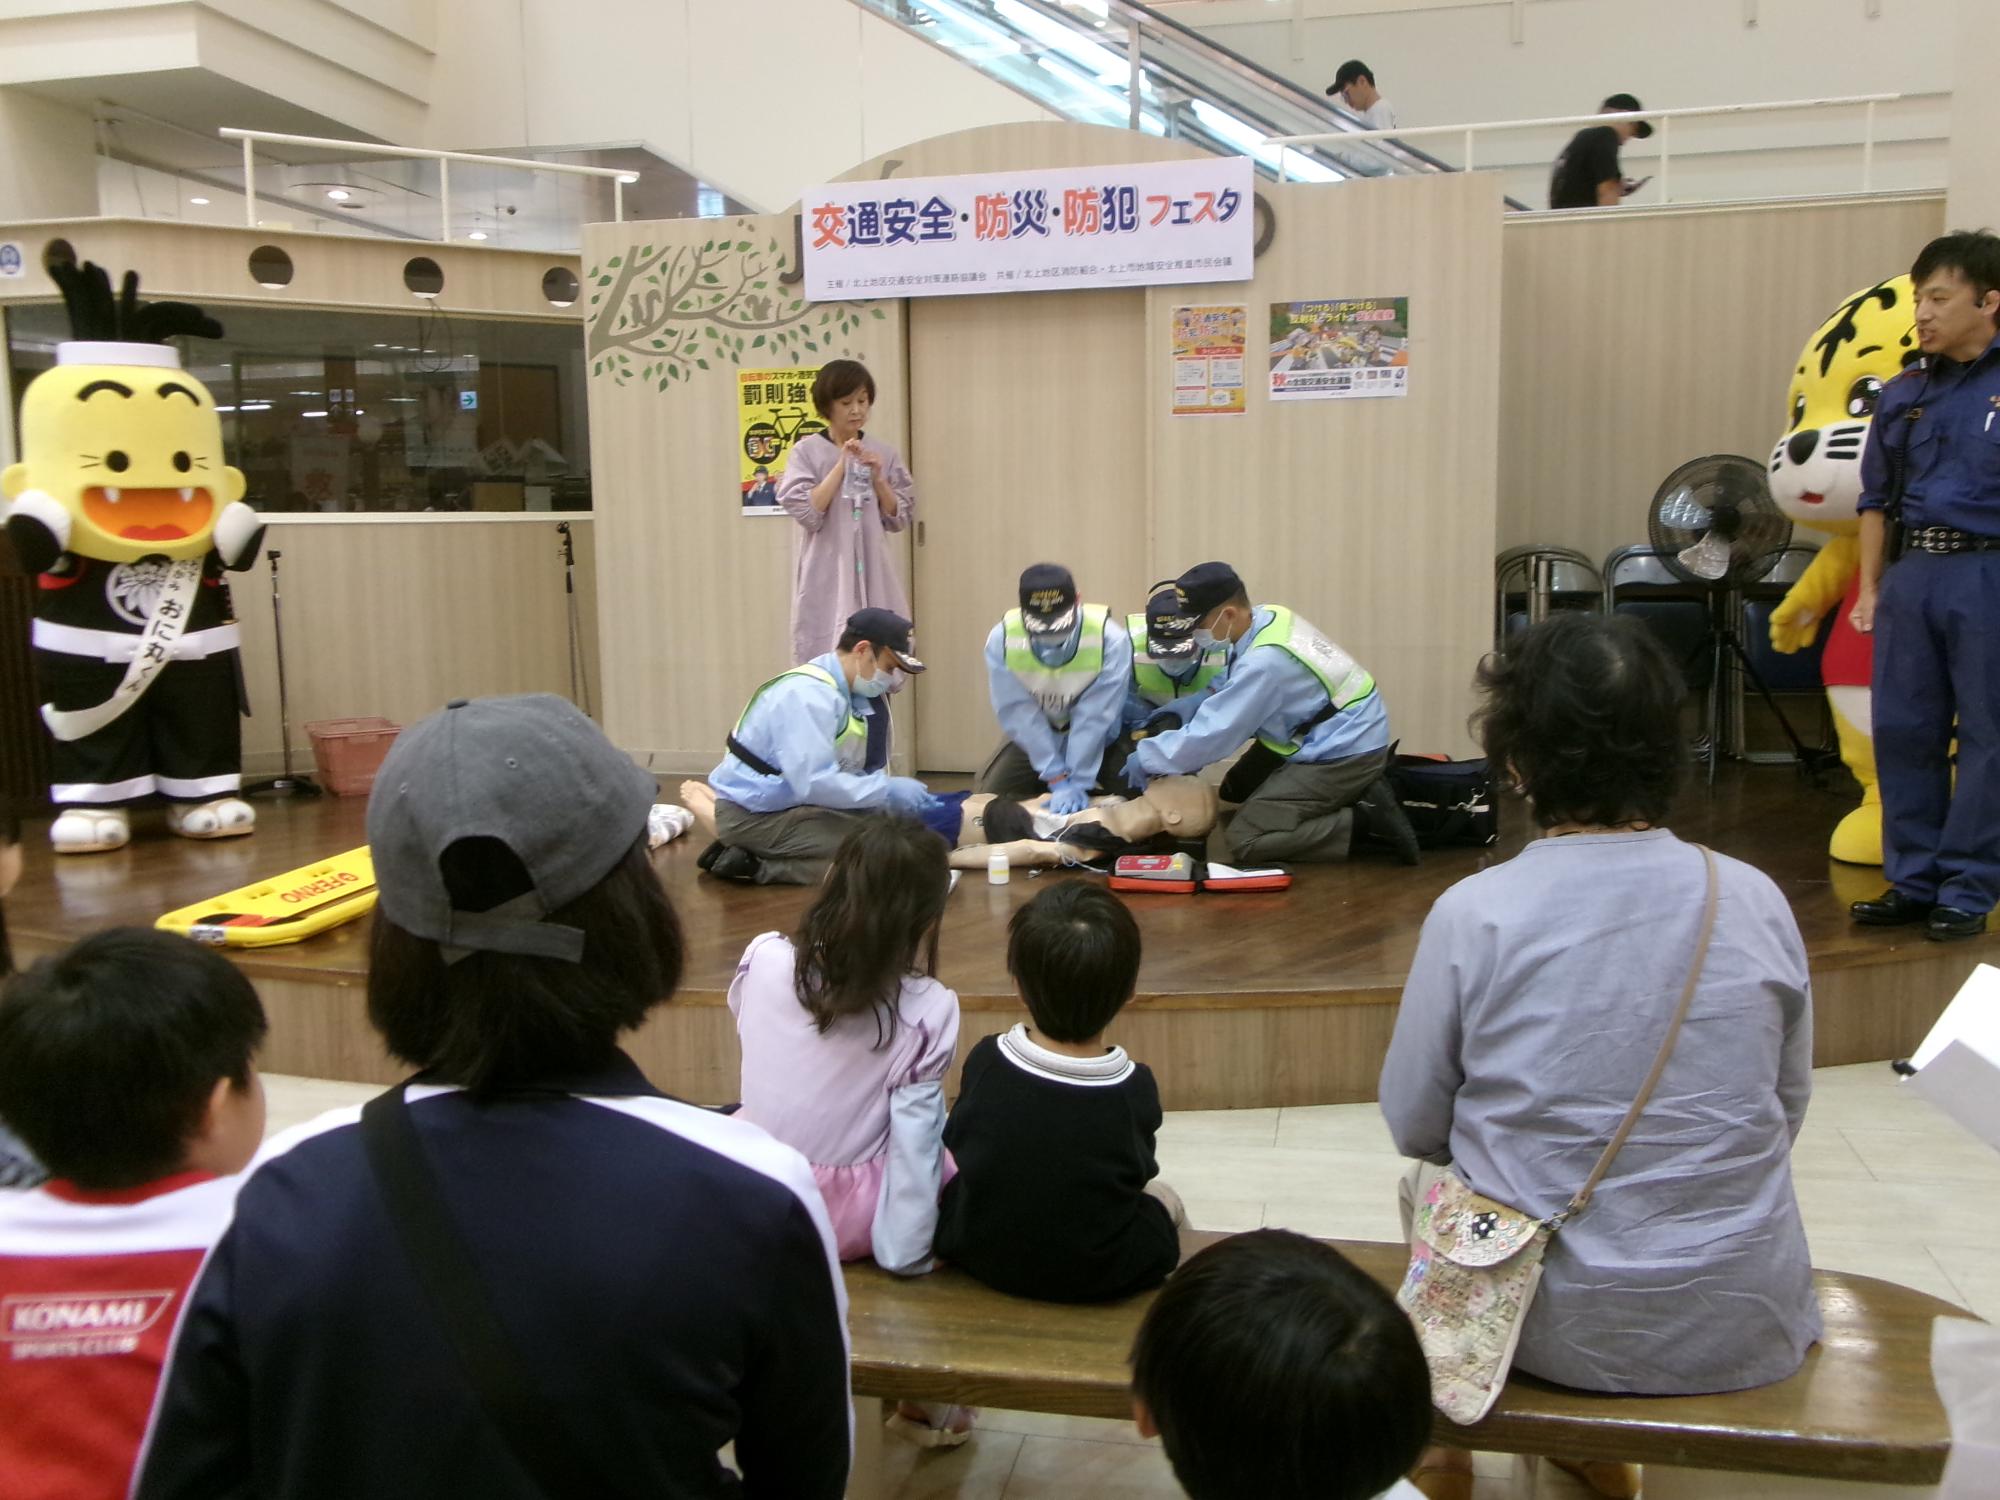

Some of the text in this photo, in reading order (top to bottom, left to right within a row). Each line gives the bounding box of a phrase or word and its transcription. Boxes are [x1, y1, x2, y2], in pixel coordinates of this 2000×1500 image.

[744, 382, 814, 406] 罰則強
[12, 1300, 147, 1332] KONAMI
